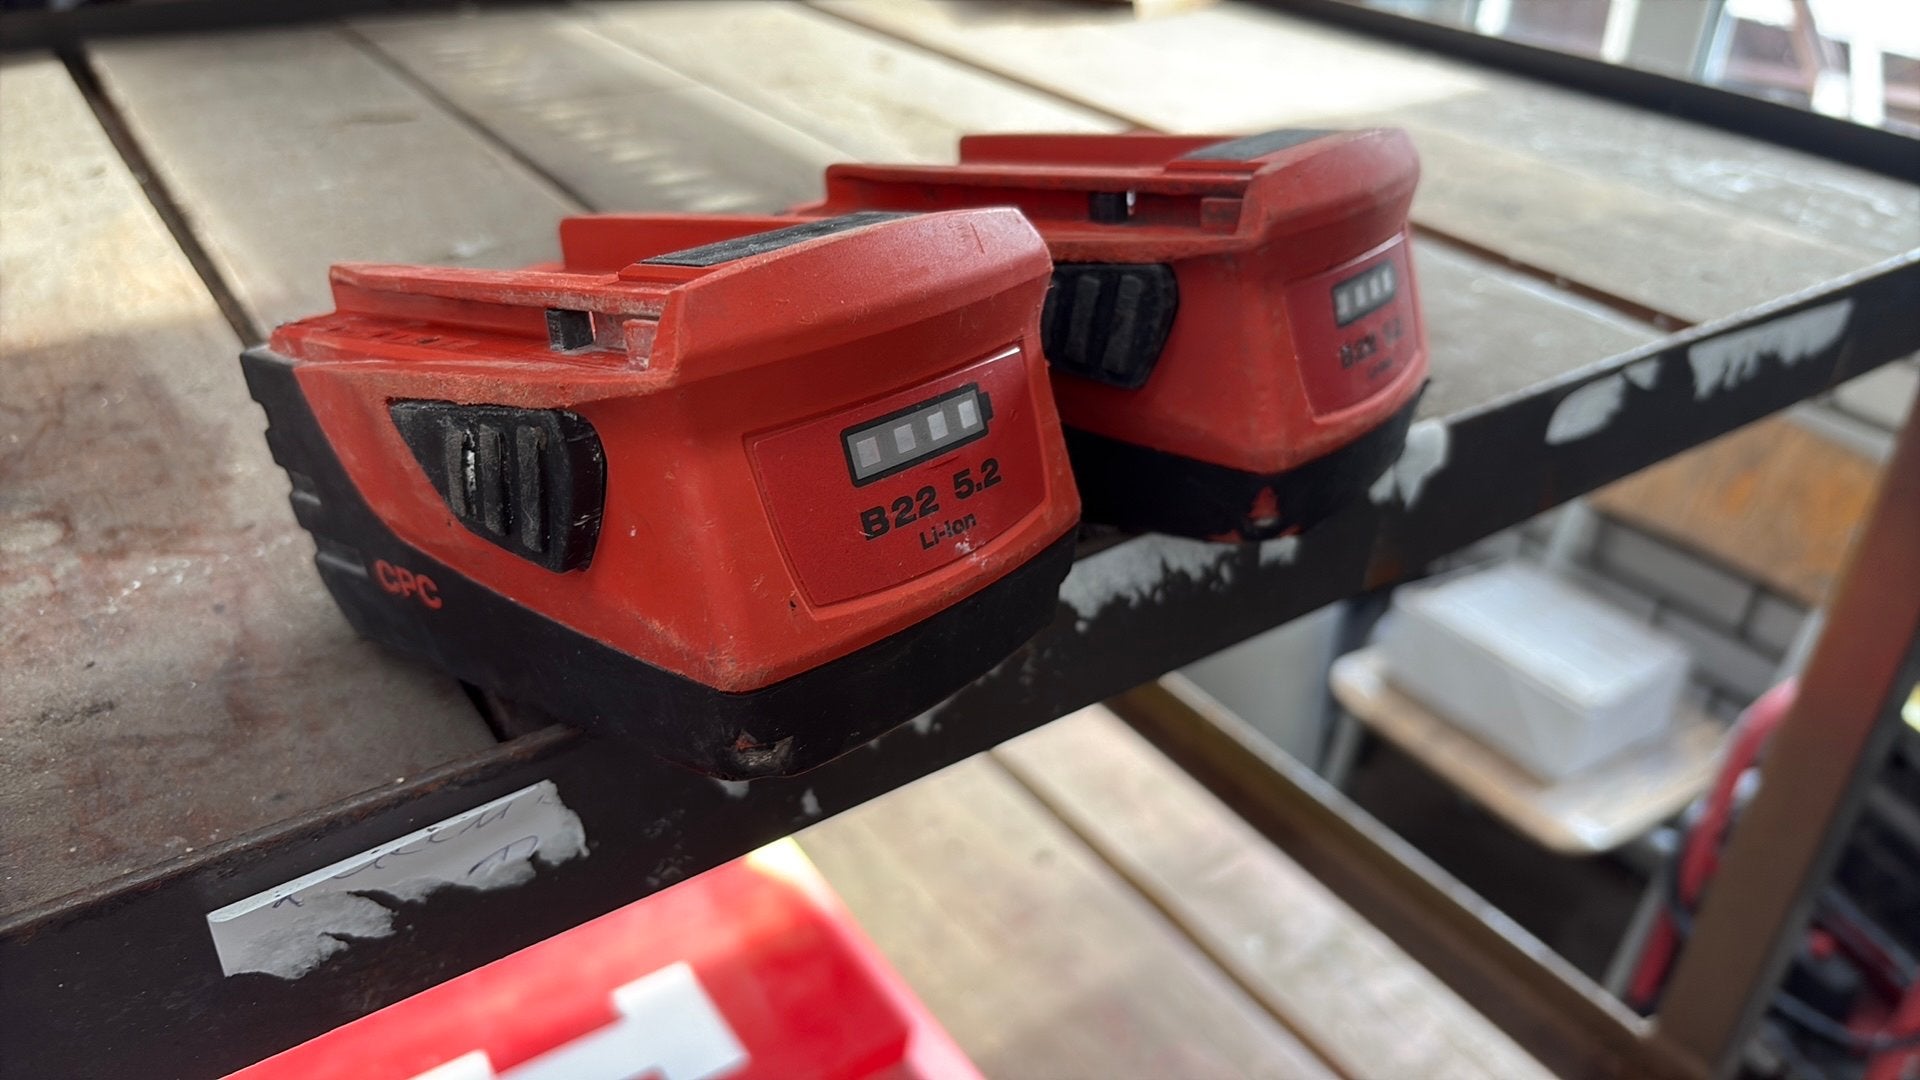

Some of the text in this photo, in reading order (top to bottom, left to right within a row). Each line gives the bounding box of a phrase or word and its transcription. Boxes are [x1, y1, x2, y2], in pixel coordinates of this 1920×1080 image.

[860, 458, 1002, 541] B22 5.2
[919, 513, 977, 550] Li-Ion
[375, 559, 442, 610] CPC
